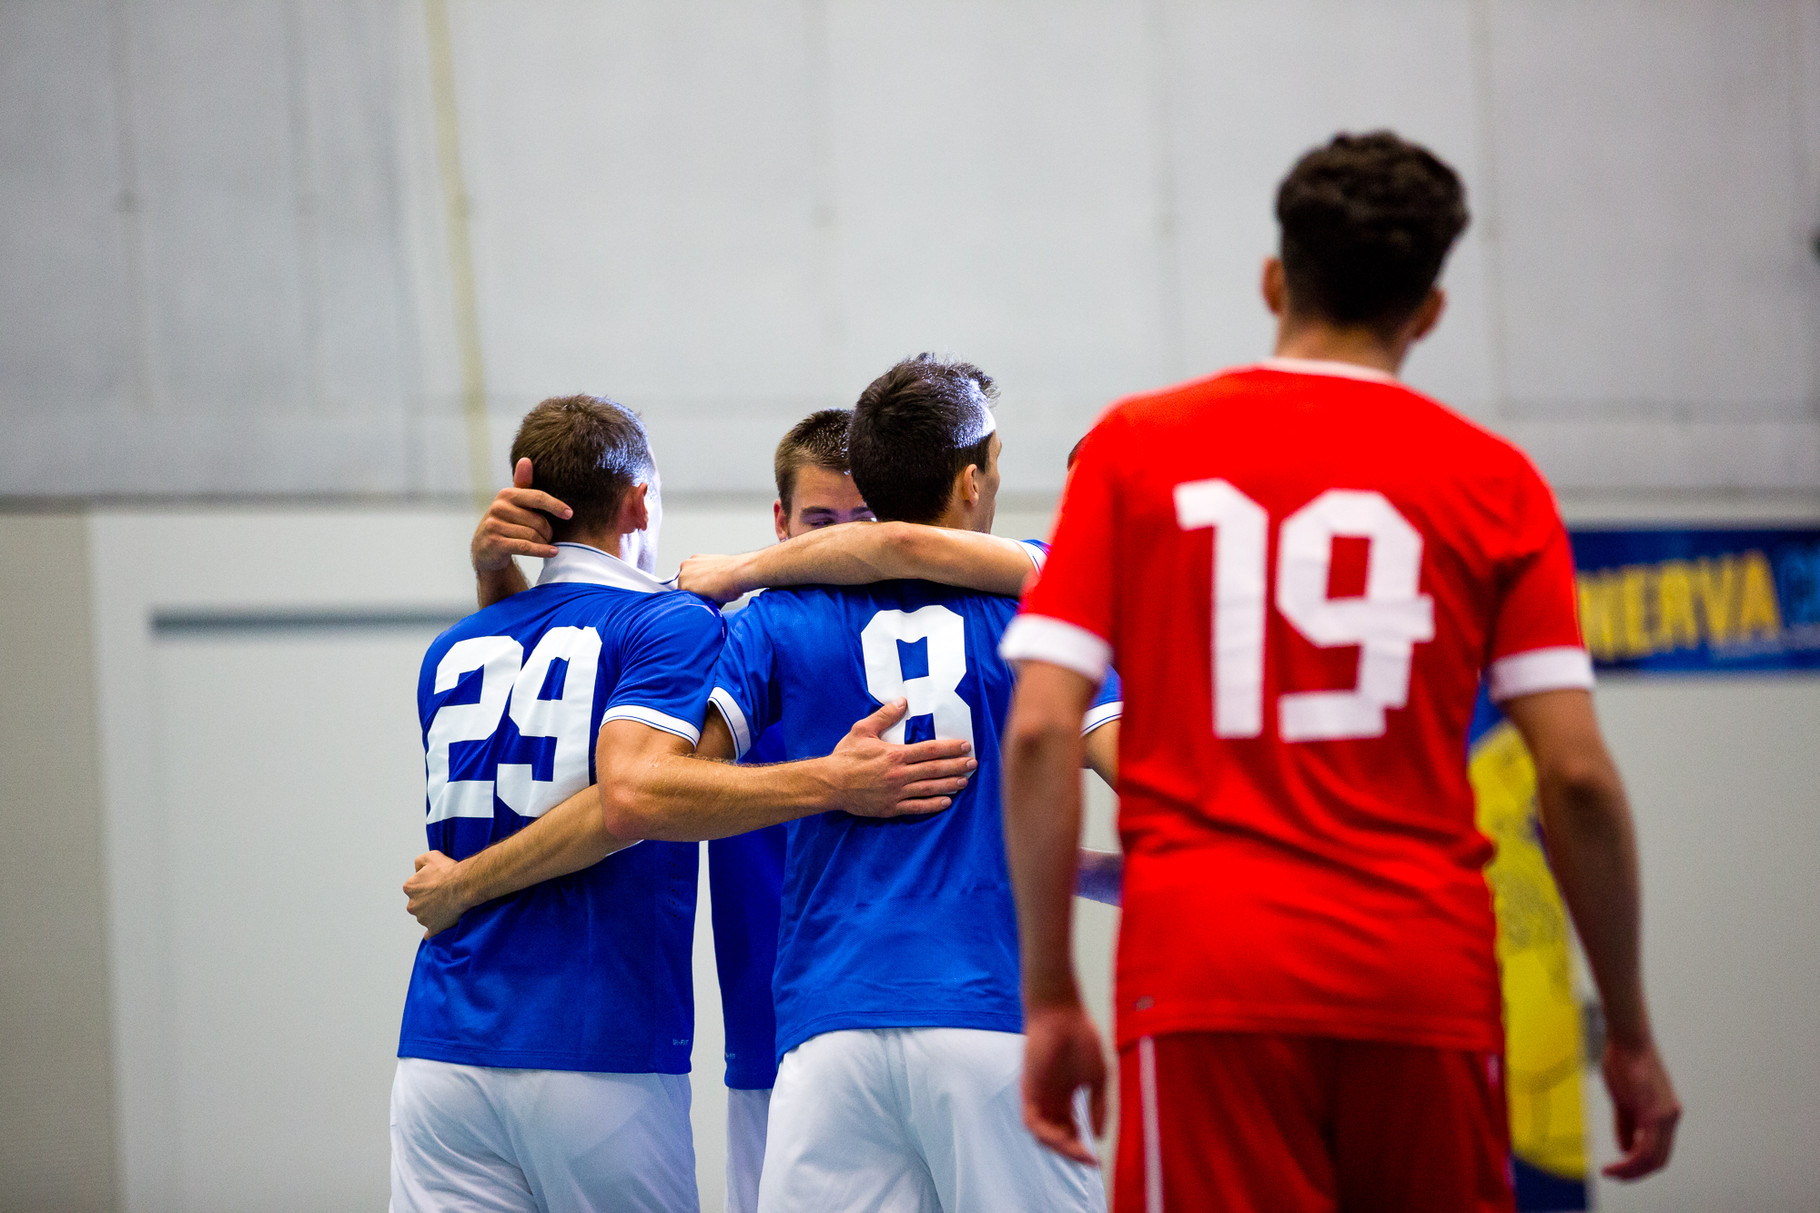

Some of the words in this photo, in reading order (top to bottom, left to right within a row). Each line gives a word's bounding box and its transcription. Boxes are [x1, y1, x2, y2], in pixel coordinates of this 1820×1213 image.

[861, 605, 975, 794] 8
[1173, 477, 1435, 742] 19
[426, 625, 603, 824] 29
